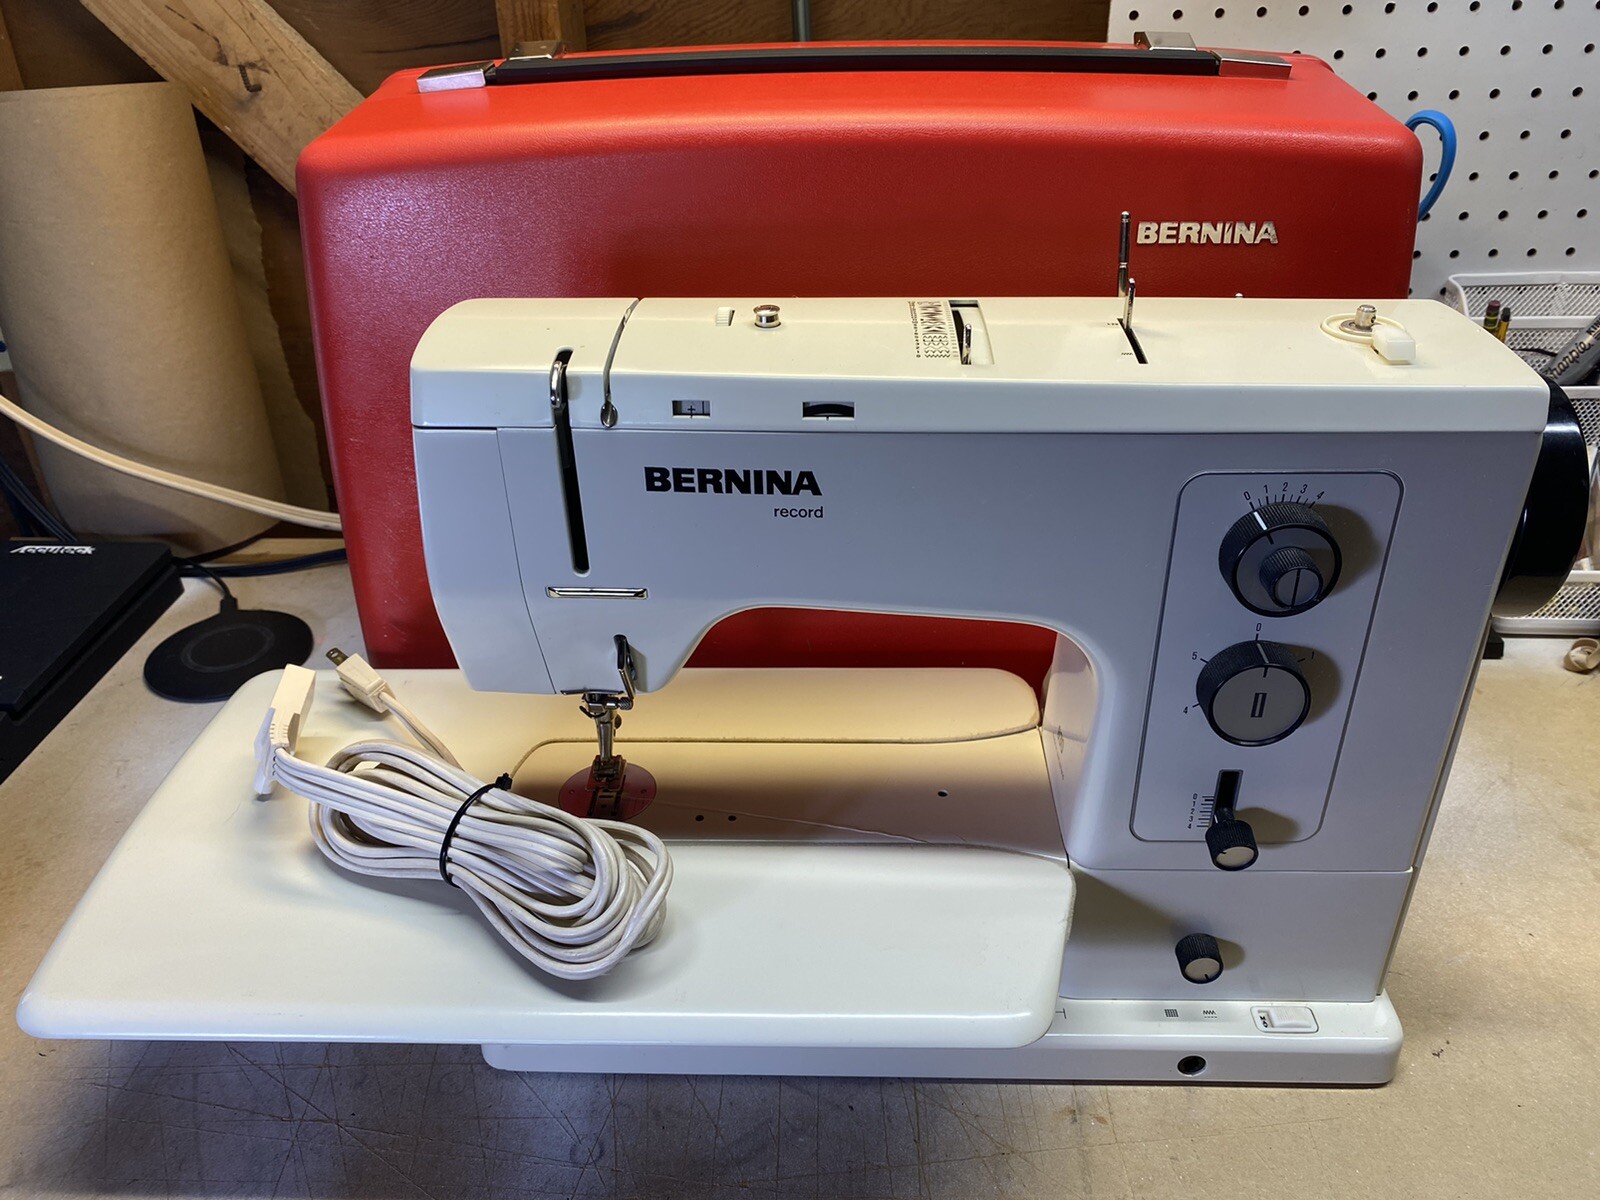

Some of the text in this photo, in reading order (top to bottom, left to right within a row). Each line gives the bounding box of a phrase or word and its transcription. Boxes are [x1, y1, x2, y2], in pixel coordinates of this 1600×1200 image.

[1136, 221, 1279, 245] BERNINA
[644, 466, 822, 496] BERNINA
[1243, 482, 1325, 501] 0 1 2 3 4
[773, 506, 824, 519] record
[1255, 622, 1262, 632] 0
[1191, 651, 1198, 660] 5
[1182, 706, 1189, 714] 4
